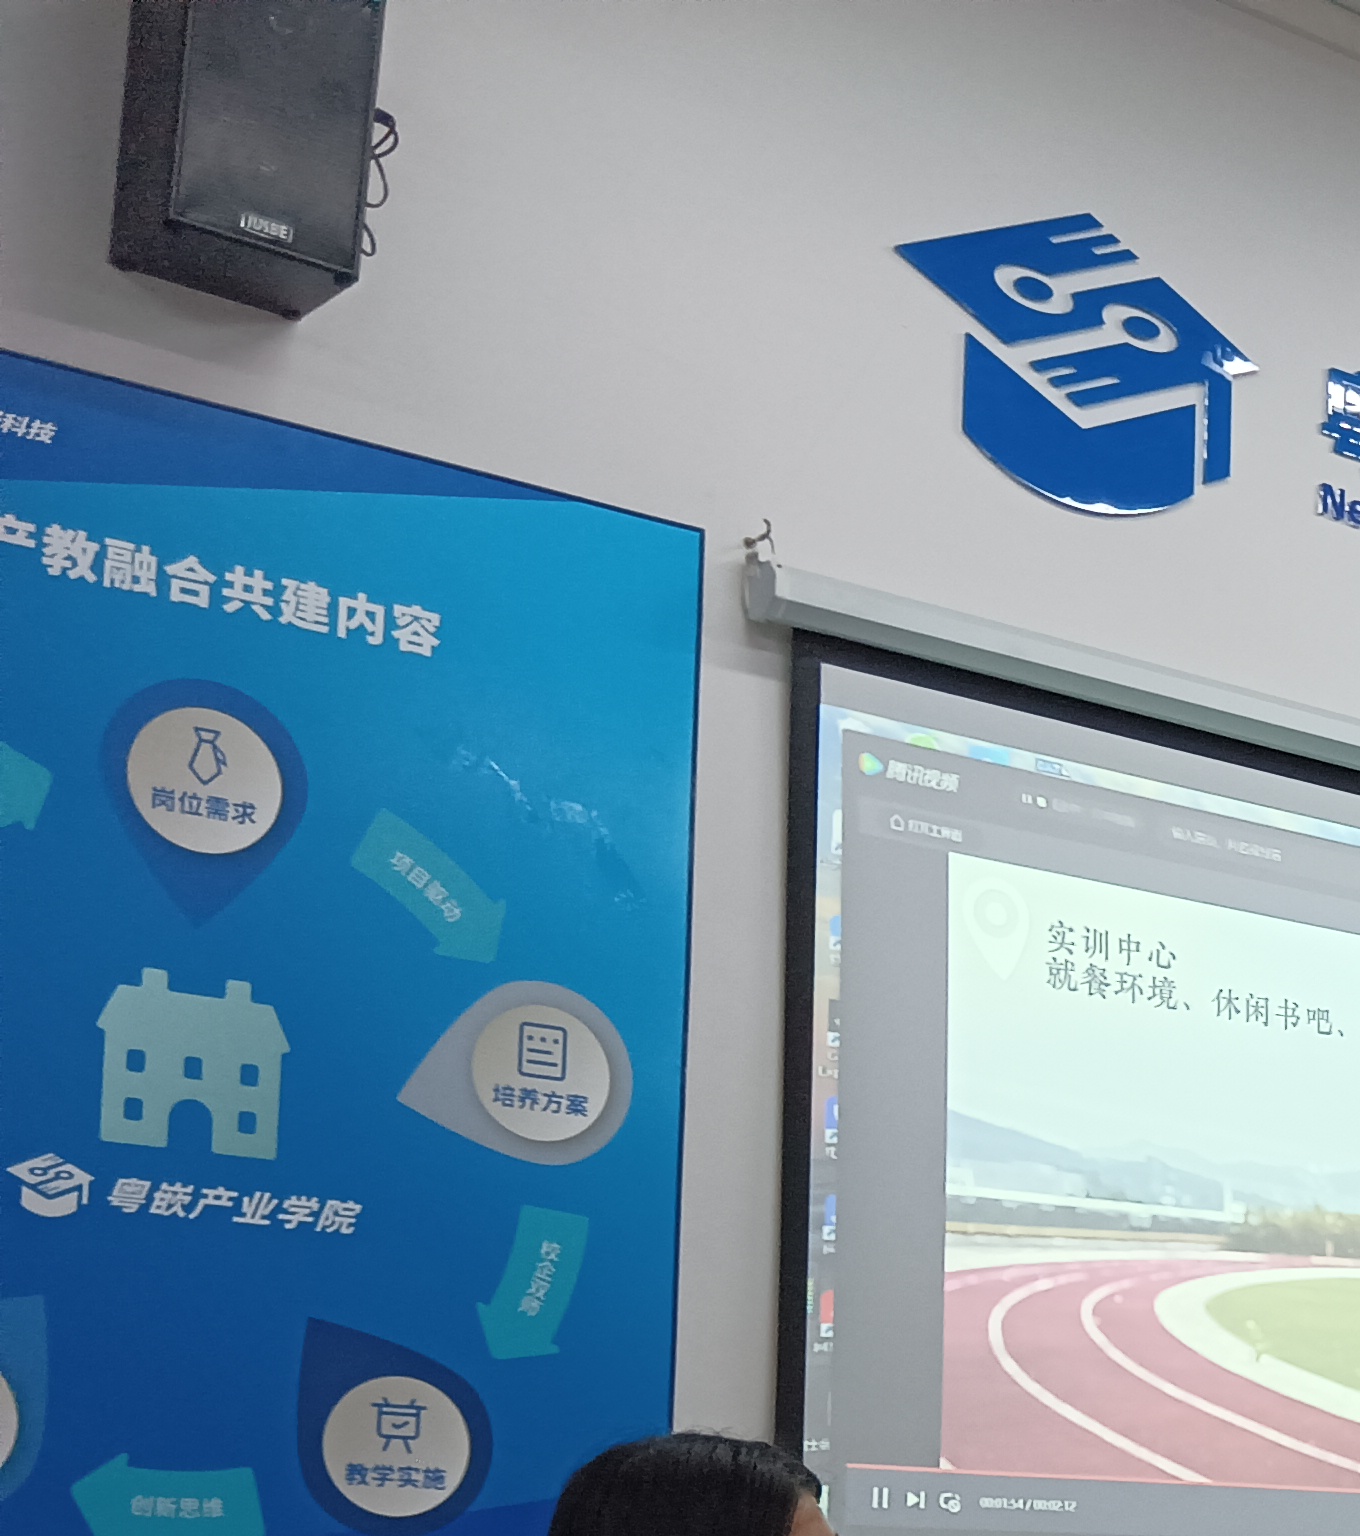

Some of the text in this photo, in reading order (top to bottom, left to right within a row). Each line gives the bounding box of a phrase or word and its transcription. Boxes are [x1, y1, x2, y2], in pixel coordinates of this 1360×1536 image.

[0, 514, 442, 658] 产教融合共建内容
[150, 786, 258, 825] 岗位需求
[1046, 920, 1178, 970] 实训中心
[492, 1083, 589, 1119] 培养方案
[106, 1177, 363, 1235] 粤嵌产业学院
[345, 1463, 448, 1490] 教学实施
[130, 1494, 226, 1519] 创新思维
